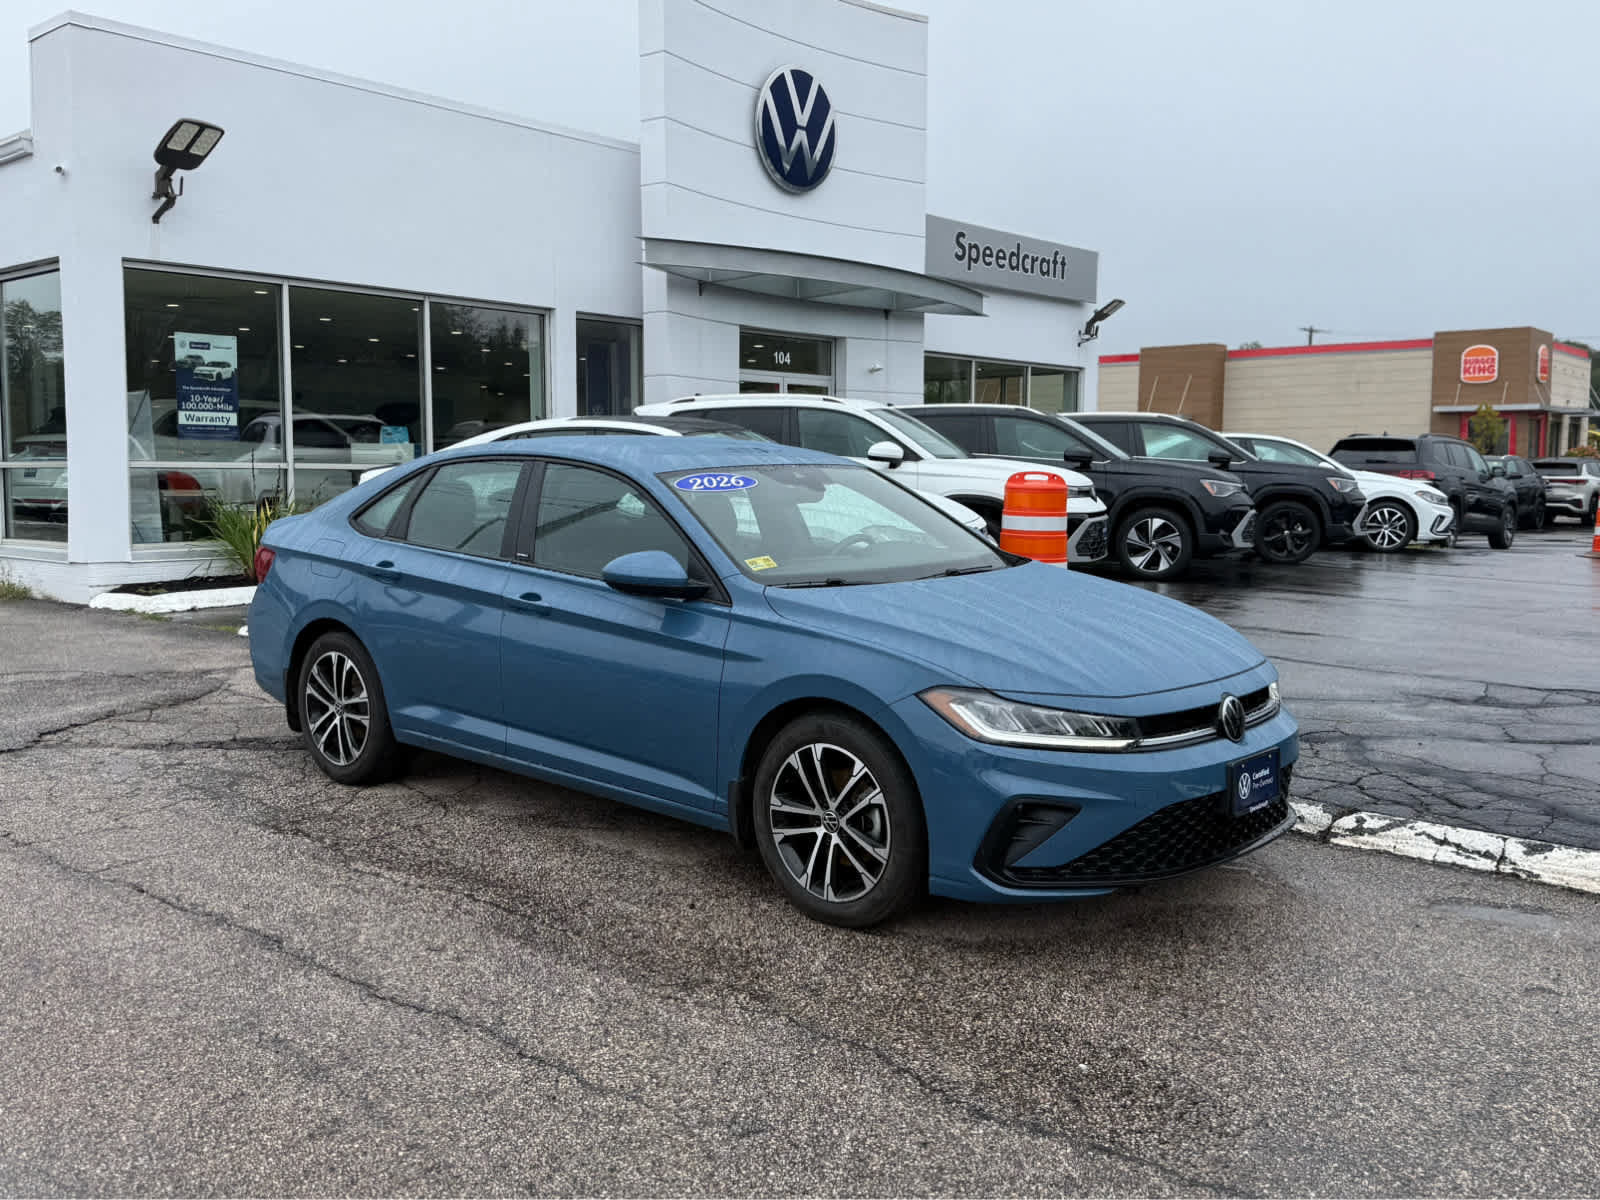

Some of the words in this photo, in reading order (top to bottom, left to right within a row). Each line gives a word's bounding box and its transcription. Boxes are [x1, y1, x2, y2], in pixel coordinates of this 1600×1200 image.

[954, 231, 1067, 280] Speedcraft
[773, 351, 791, 365] 104
[1463, 357, 1496, 365] BURGER
[1463, 364, 1496, 376] KING
[190, 394, 224, 403] 10-Year/
[184, 413, 231, 425] Warranty
[689, 475, 744, 490] 2026
